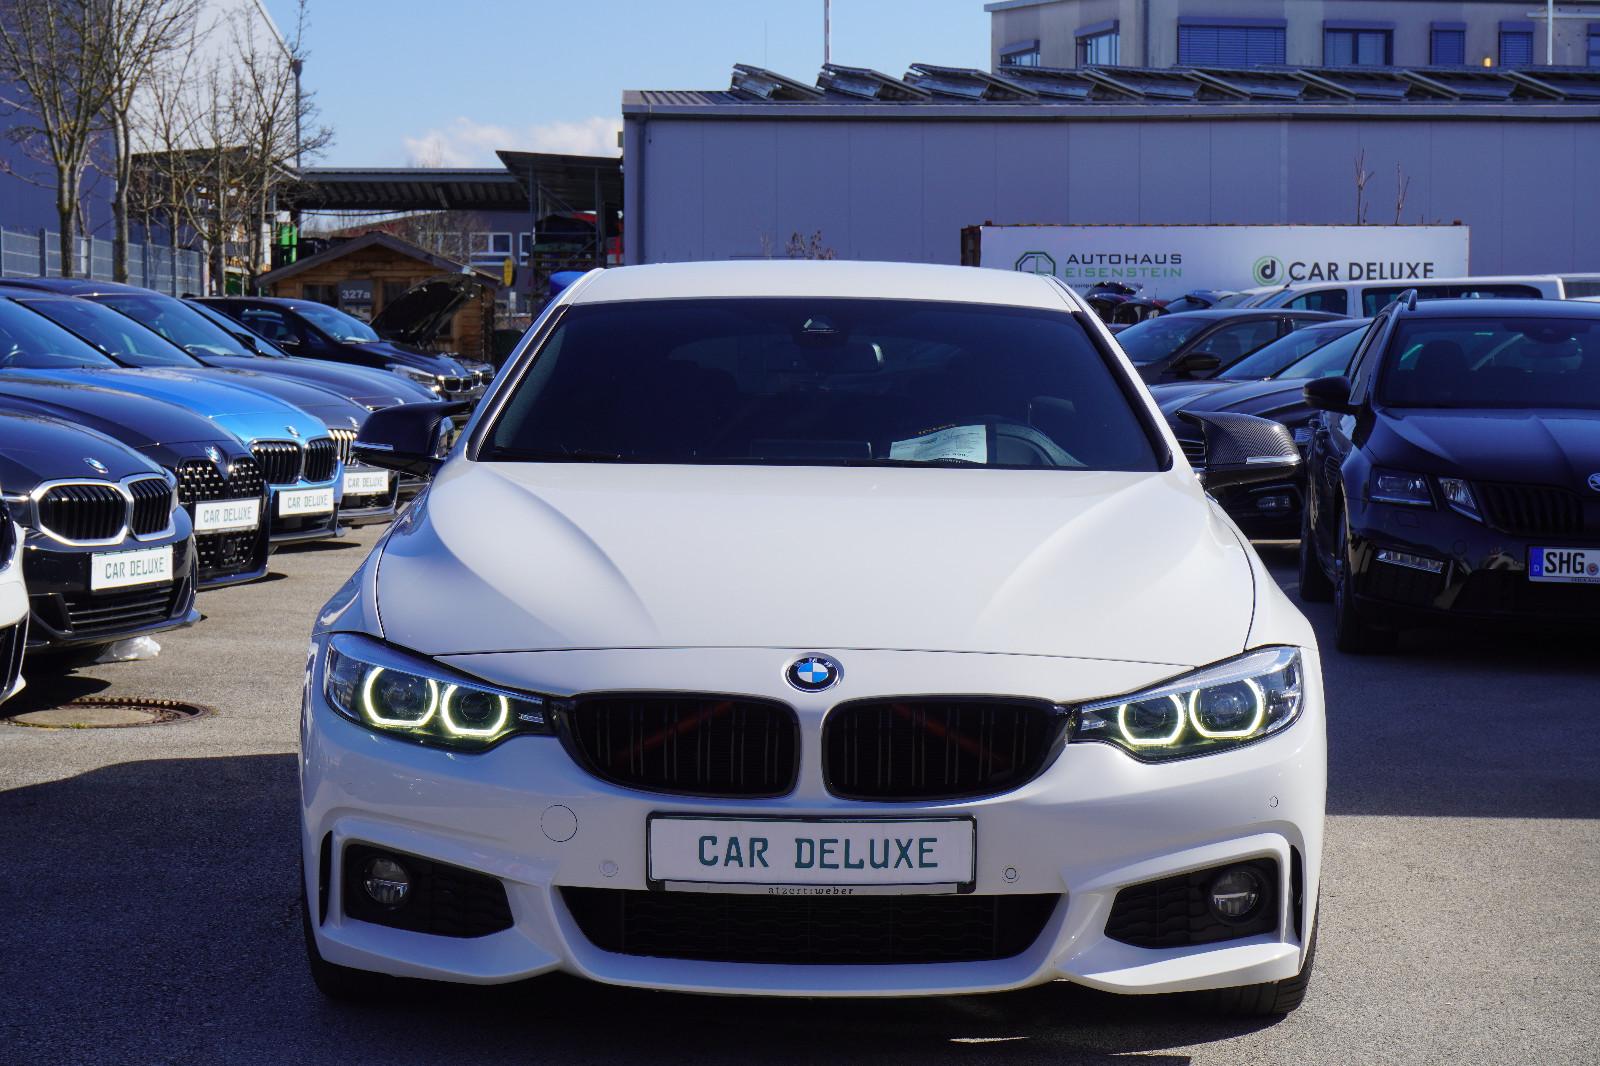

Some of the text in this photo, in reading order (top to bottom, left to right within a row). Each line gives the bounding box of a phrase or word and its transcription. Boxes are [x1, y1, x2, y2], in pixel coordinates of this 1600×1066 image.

[1067, 254, 1182, 265] AUTOHAUS
[1065, 267, 1182, 278] EISENSTEIN
[1288, 261, 1340, 282] CAR
[1348, 261, 1435, 281] DELUXE
[342, 289, 371, 300] 327a
[347, 477, 361, 489] CAR
[287, 494, 329, 509] CAR DELUXE
[203, 506, 252, 523] CAR DELUXE
[105, 557, 164, 579] CAR DELUXE
[1544, 551, 1585, 574] SHG
[698, 835, 939, 870] CAR DELUXE
